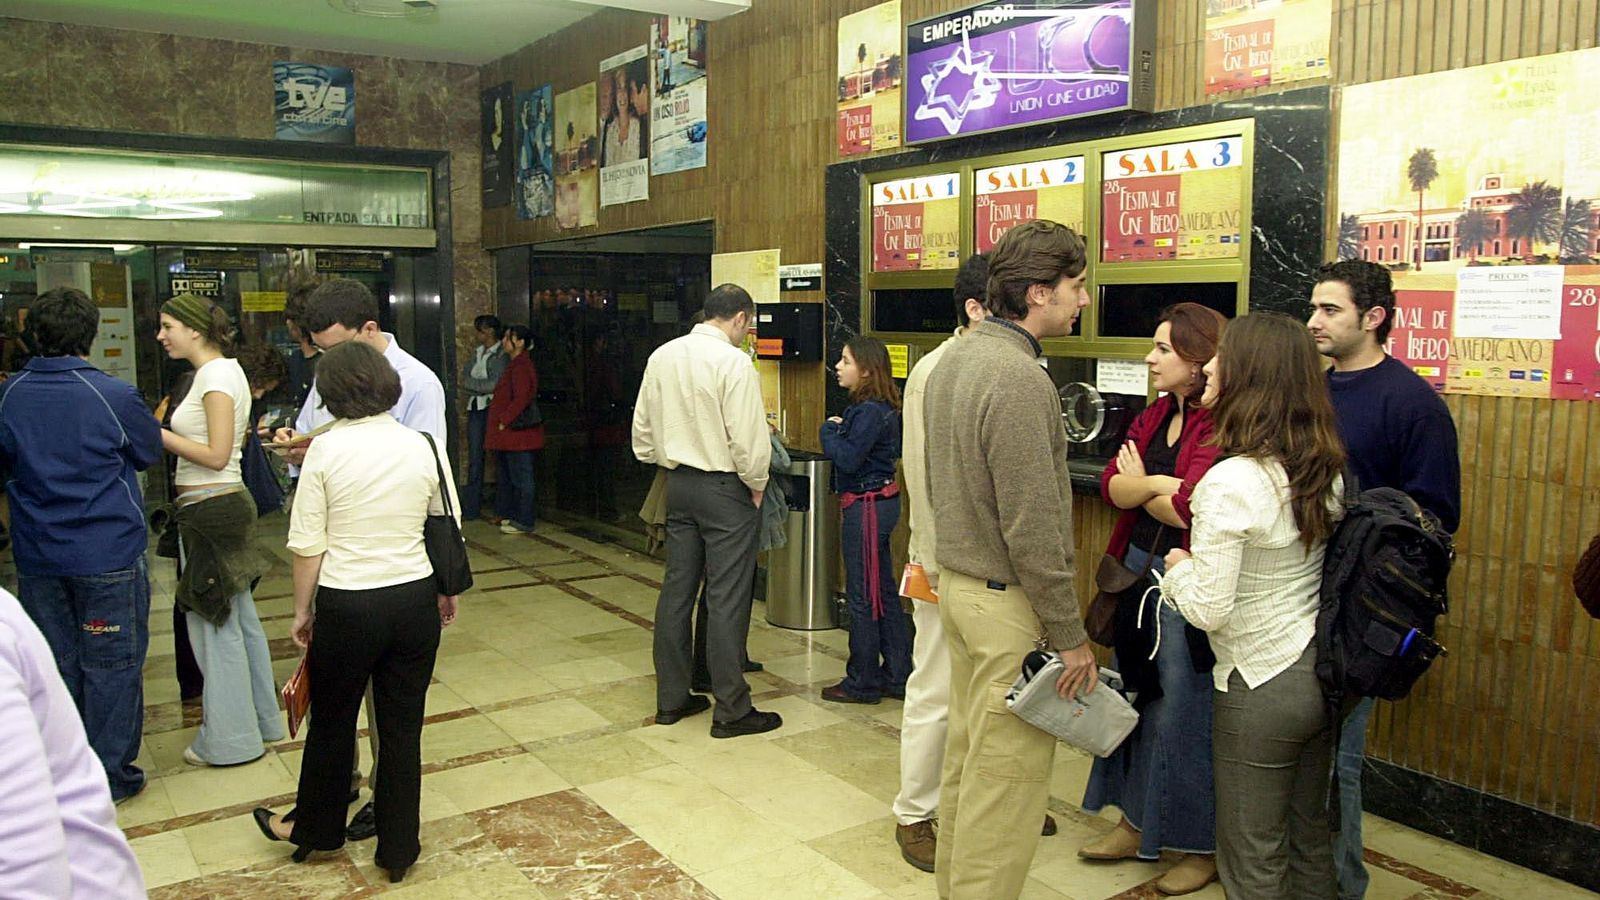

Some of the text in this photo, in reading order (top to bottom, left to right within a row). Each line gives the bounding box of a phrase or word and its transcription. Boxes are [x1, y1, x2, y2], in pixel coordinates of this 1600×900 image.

[922, 5, 1014, 42] EMPERADOR
[283, 77, 346, 111] tve
[1009, 82, 1120, 113] UNION CINE CIUDAD
[661, 103, 673, 119] OSO
[1119, 141, 1231, 177] SALA 3
[988, 161, 1077, 191] SALA 2
[883, 178, 954, 203] SALA 1
[1104, 181, 1176, 211] 28 FESTIVAL DE
[884, 211, 912, 231] FESTIVAL
[977, 195, 1035, 222] 28 FESTIVAL DE
[1119, 211, 1144, 236] CINE
[1568, 288, 1597, 307] 28
[1432, 310, 1448, 330] DE
